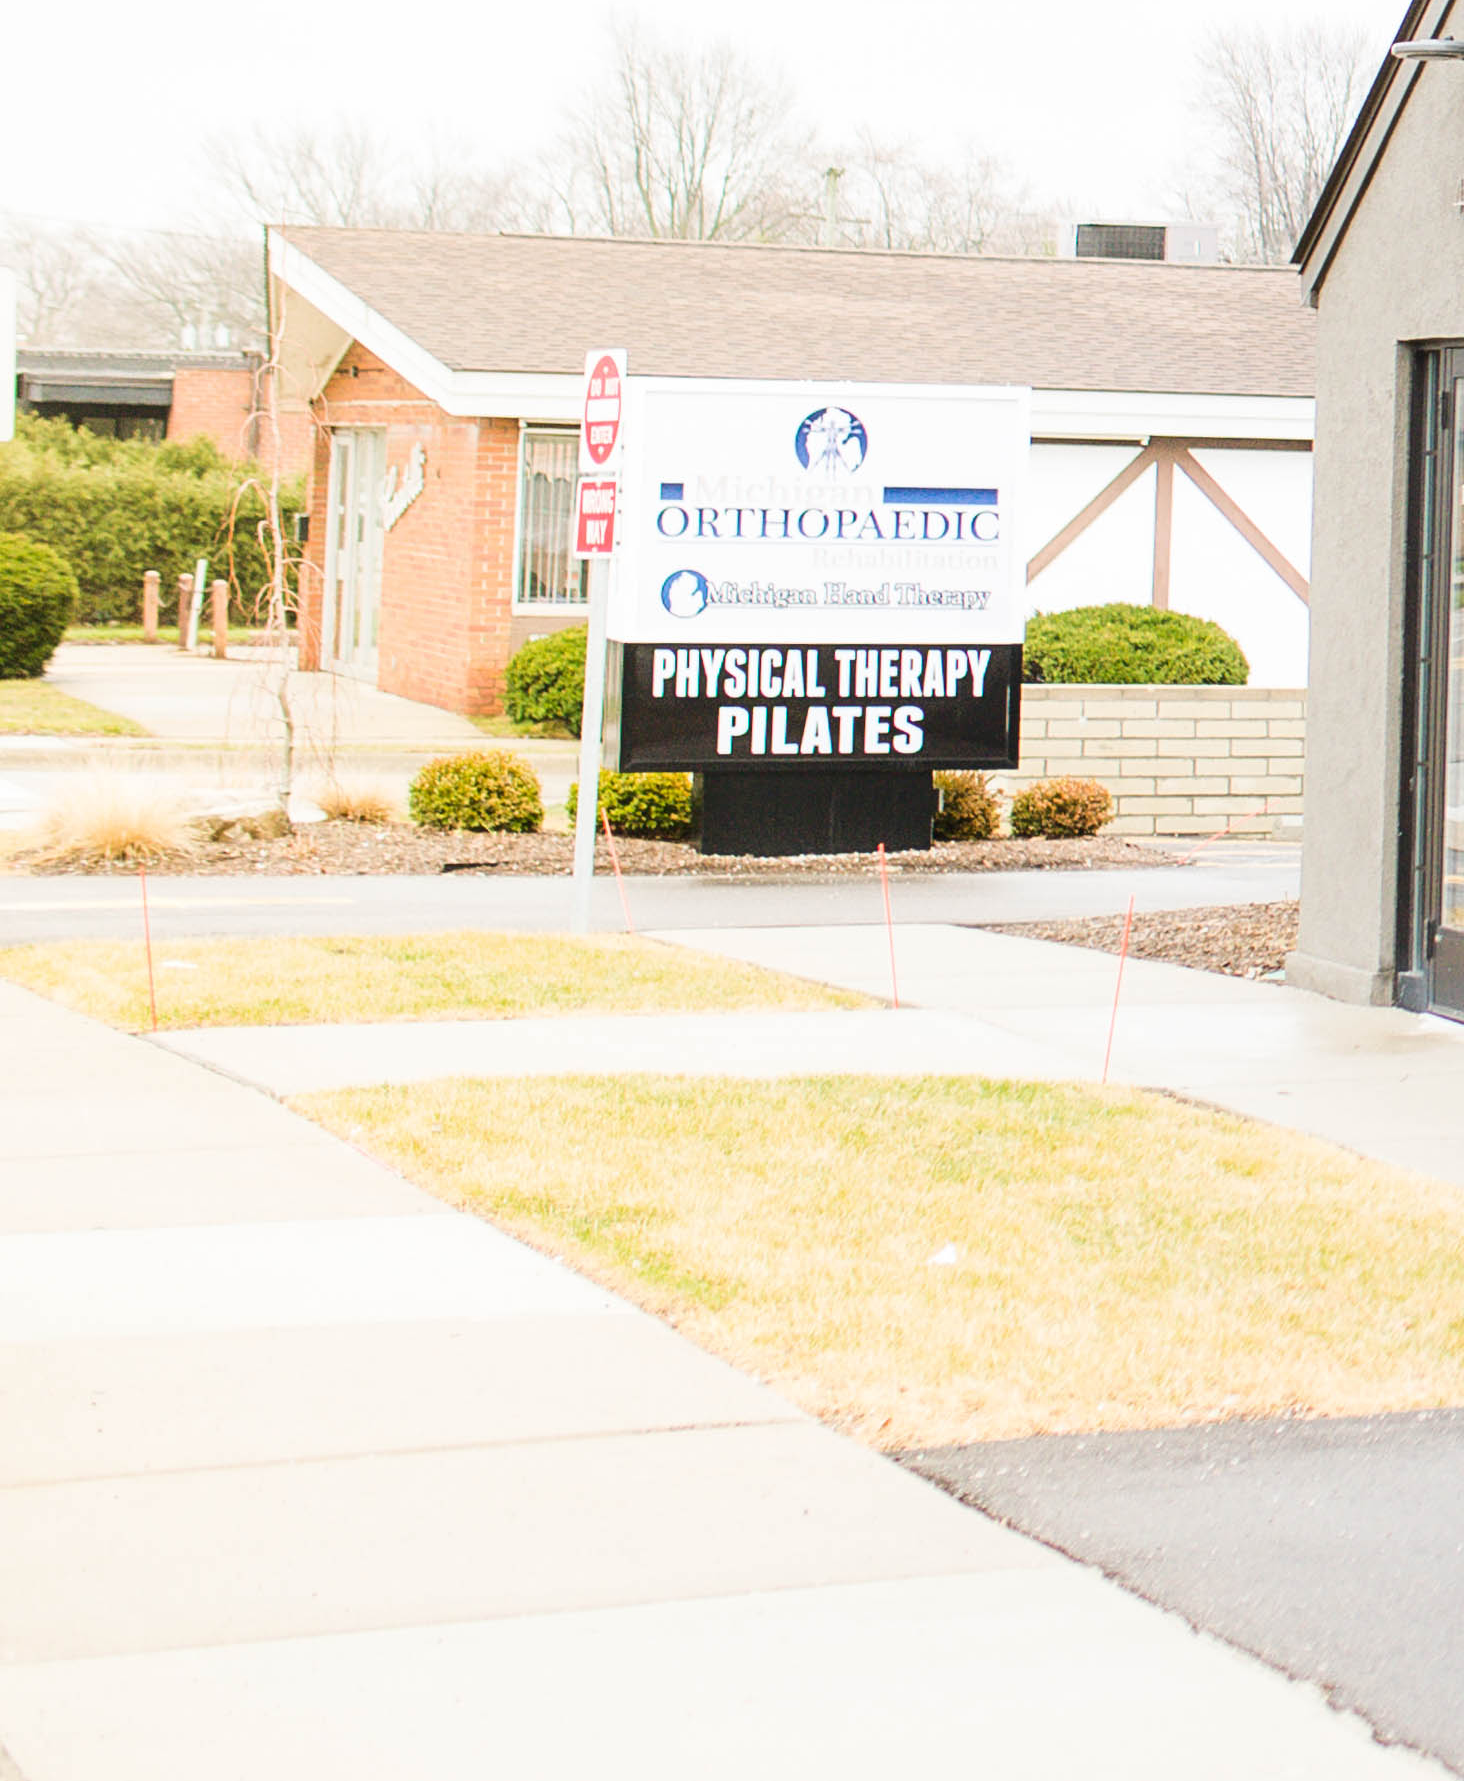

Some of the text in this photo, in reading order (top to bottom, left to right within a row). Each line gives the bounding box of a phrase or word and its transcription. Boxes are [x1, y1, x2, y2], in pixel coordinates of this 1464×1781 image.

[591, 377, 602, 397] DO
[590, 425, 614, 445] ENTER
[582, 488, 615, 515] WRONG
[695, 475, 874, 507] Michigan
[586, 519, 609, 545] WAY
[656, 506, 1001, 541] ORTHOPAEDIC
[706, 580, 992, 611] Michigan Hand Therapy
[652, 648, 993, 699] PHYSICAL THERAPY
[716, 704, 926, 756] PILATES
